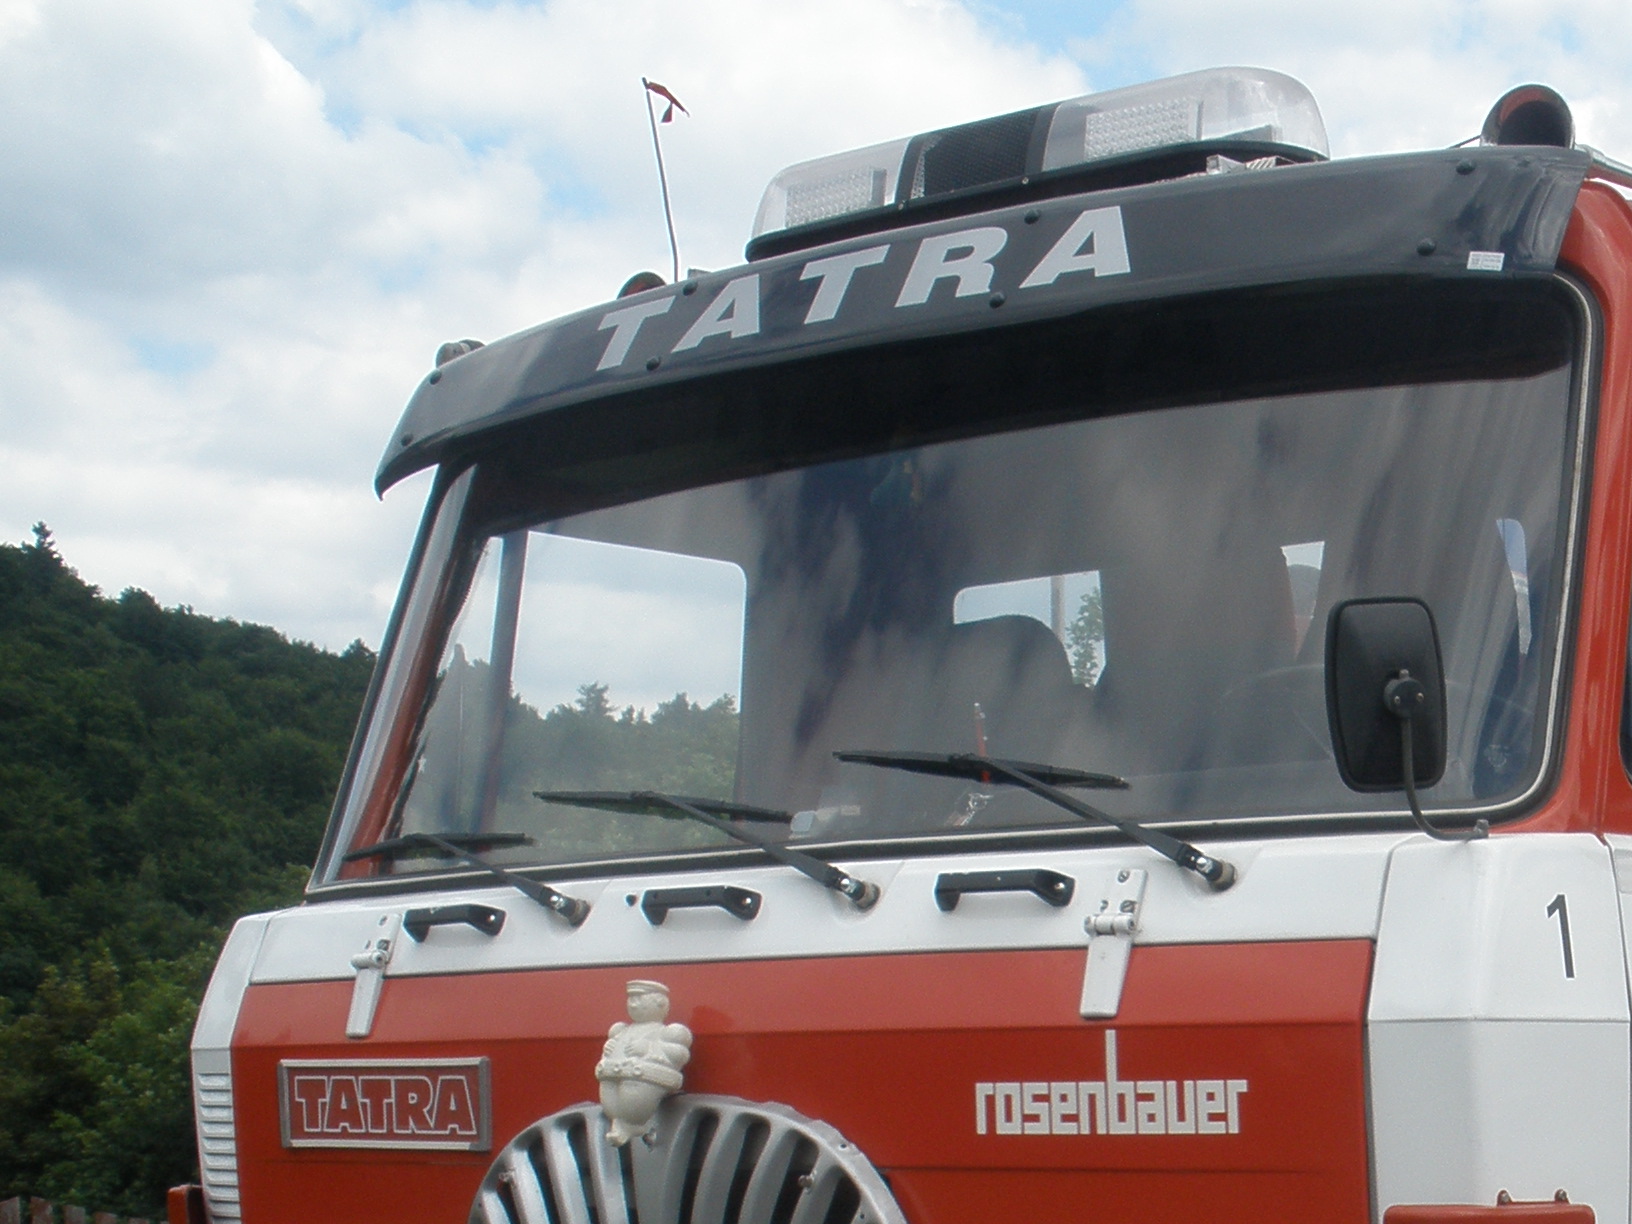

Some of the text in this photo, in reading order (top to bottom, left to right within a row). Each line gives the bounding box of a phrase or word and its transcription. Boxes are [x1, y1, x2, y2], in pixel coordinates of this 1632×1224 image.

[596, 206, 1131, 371] TATRA
[1546, 894, 1575, 978] 1
[294, 1075, 477, 1135] TATRA
[975, 1029, 1249, 1135] rosenbauer
